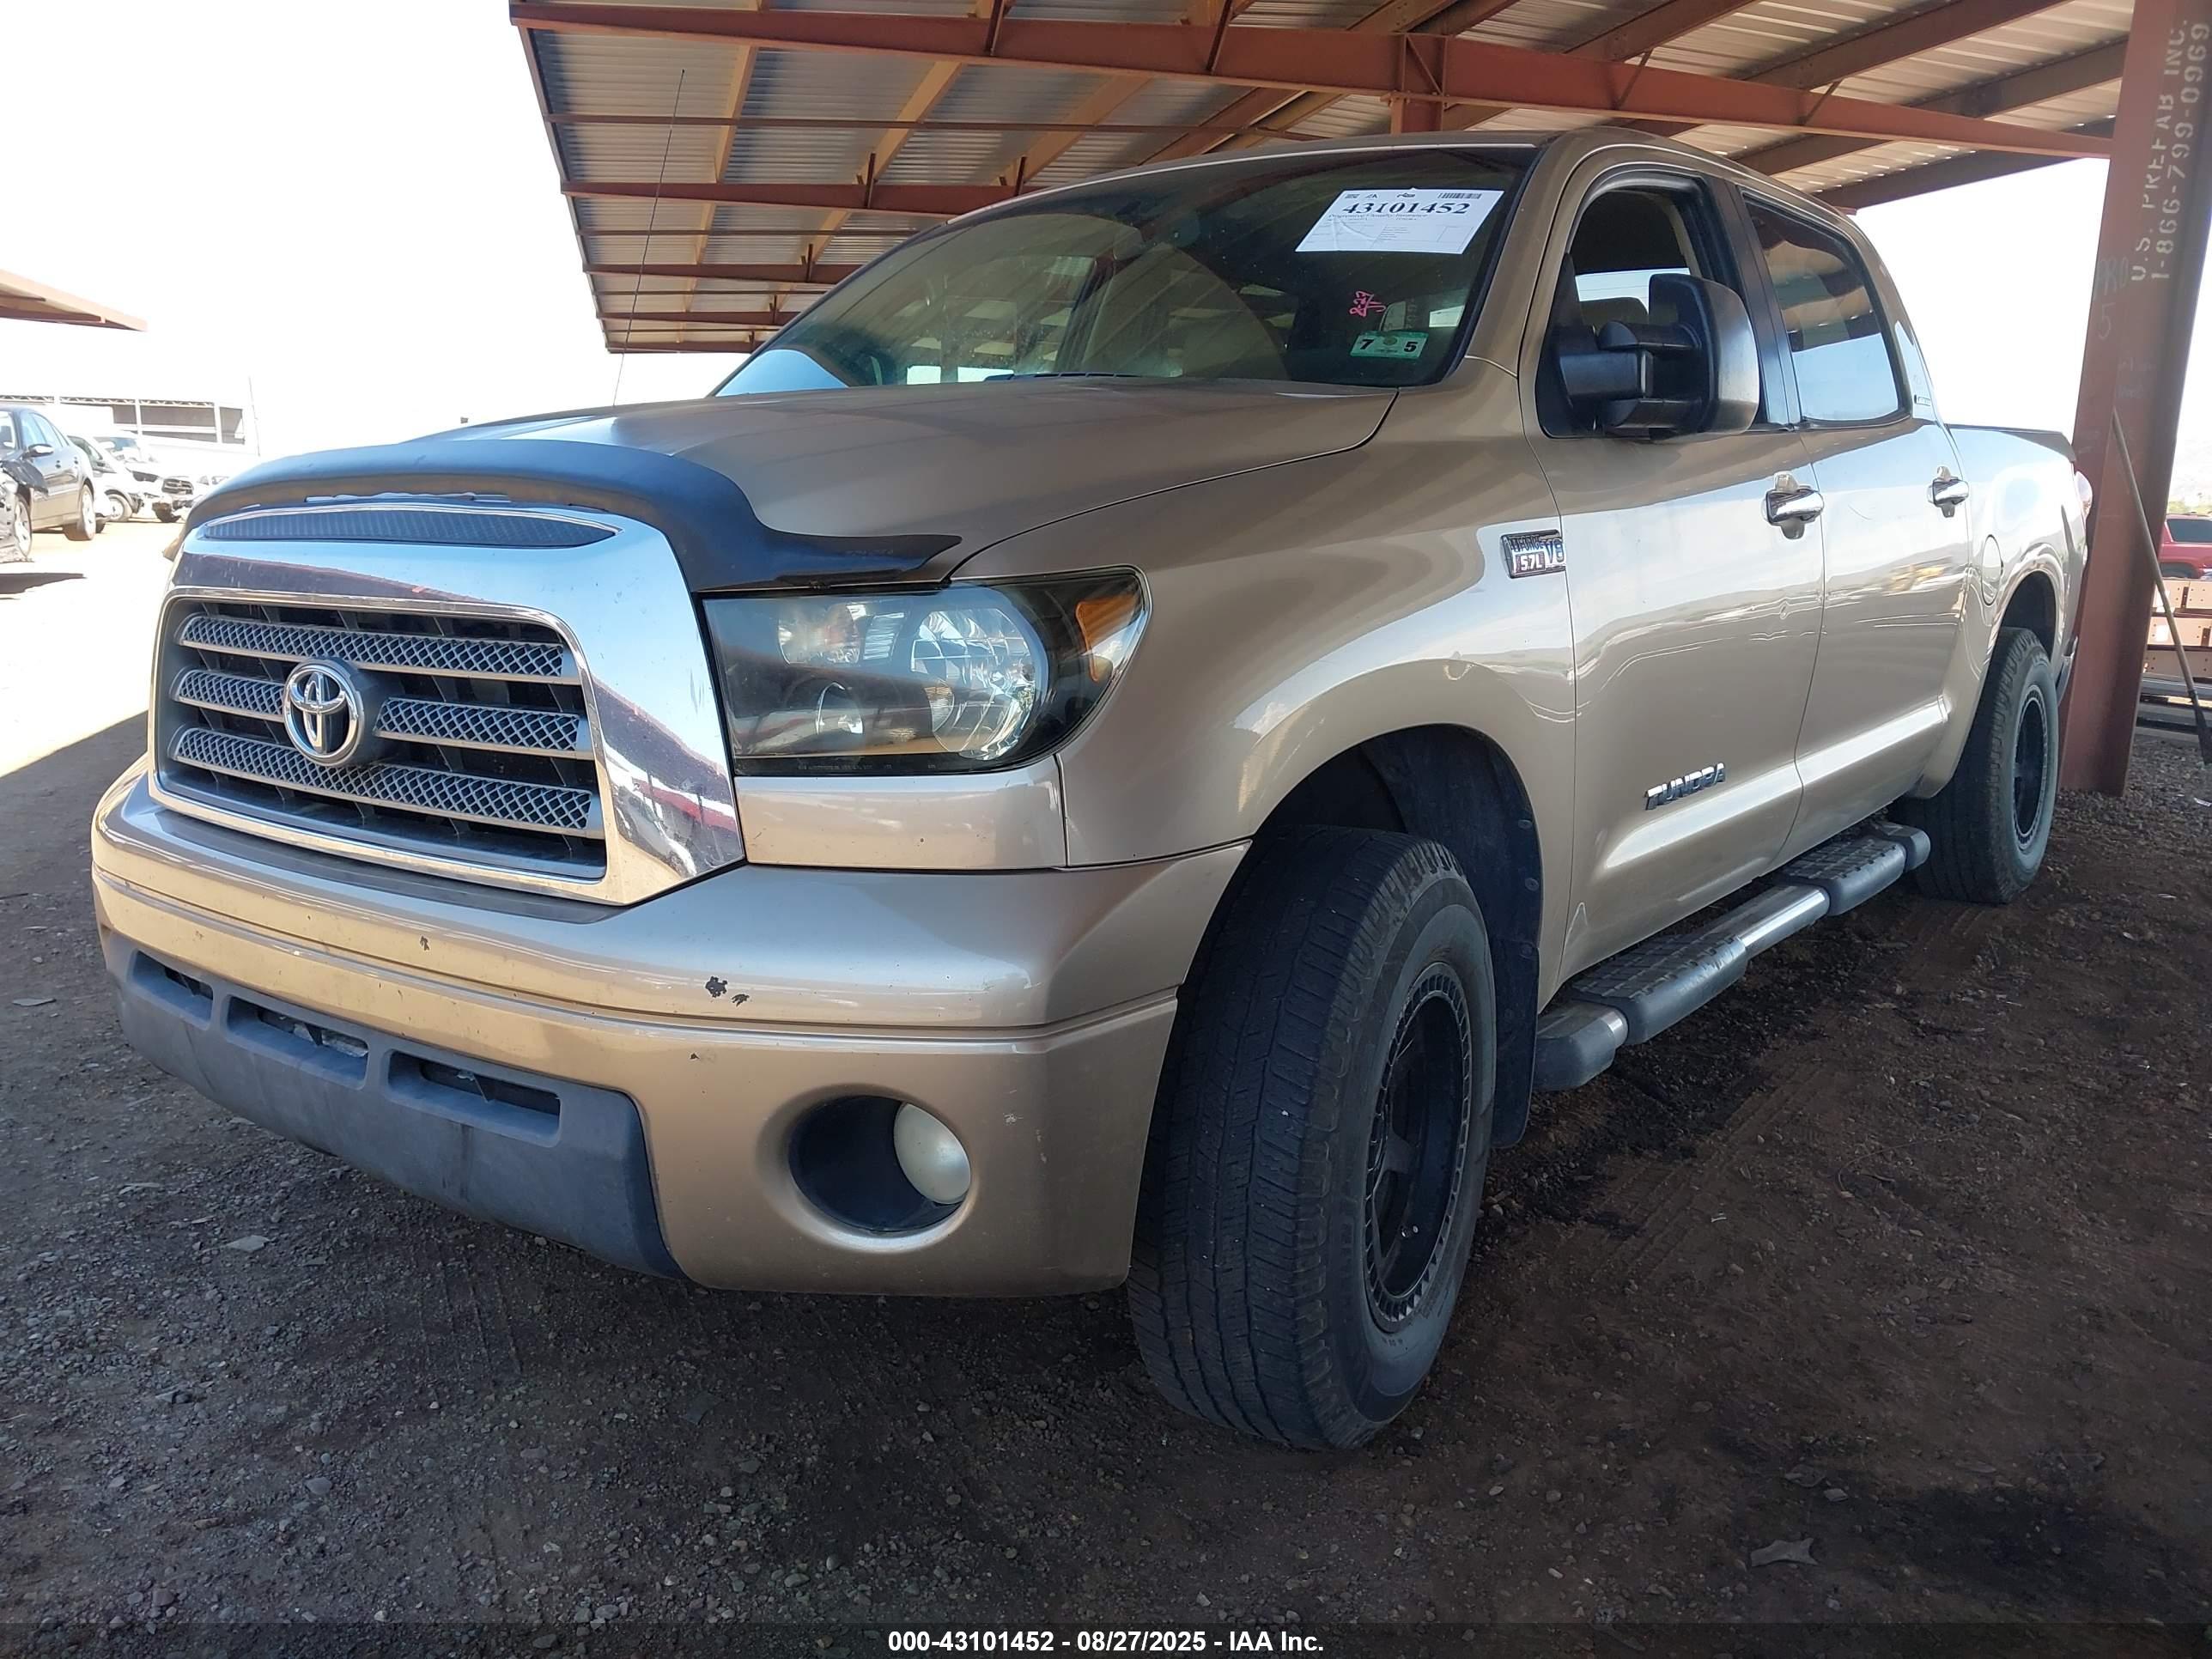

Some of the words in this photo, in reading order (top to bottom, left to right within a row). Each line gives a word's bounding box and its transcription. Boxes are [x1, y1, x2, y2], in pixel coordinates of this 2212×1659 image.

[2163, 20, 2188, 76] INC.
[2142, 94, 2174, 209] PREFAB
[2151, 22, 2210, 279] 1-866-799-0969
[1341, 202, 1471, 214] 43101452
[2131, 228, 2154, 281] U.S.
[1360, 339, 1375, 350] 7
[1404, 341, 1419, 353] 5
[1519, 552, 1544, 571] 5.7L
[1644, 763, 1726, 811] TUNDRA
